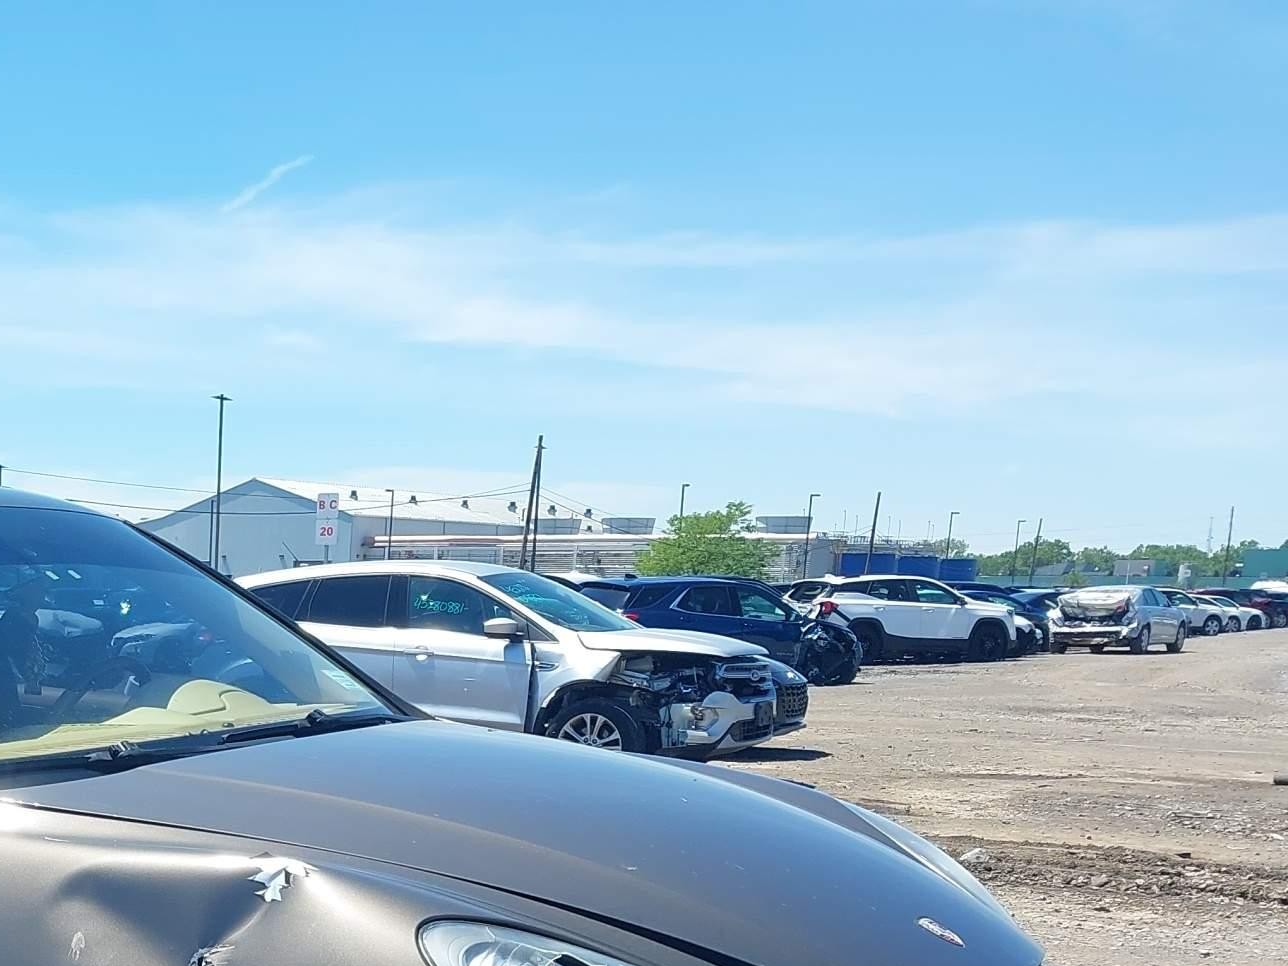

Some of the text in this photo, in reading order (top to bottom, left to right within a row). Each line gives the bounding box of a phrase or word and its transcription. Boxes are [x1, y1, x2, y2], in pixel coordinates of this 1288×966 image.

[319, 500, 338, 510] B C
[319, 527, 334, 536] 20
